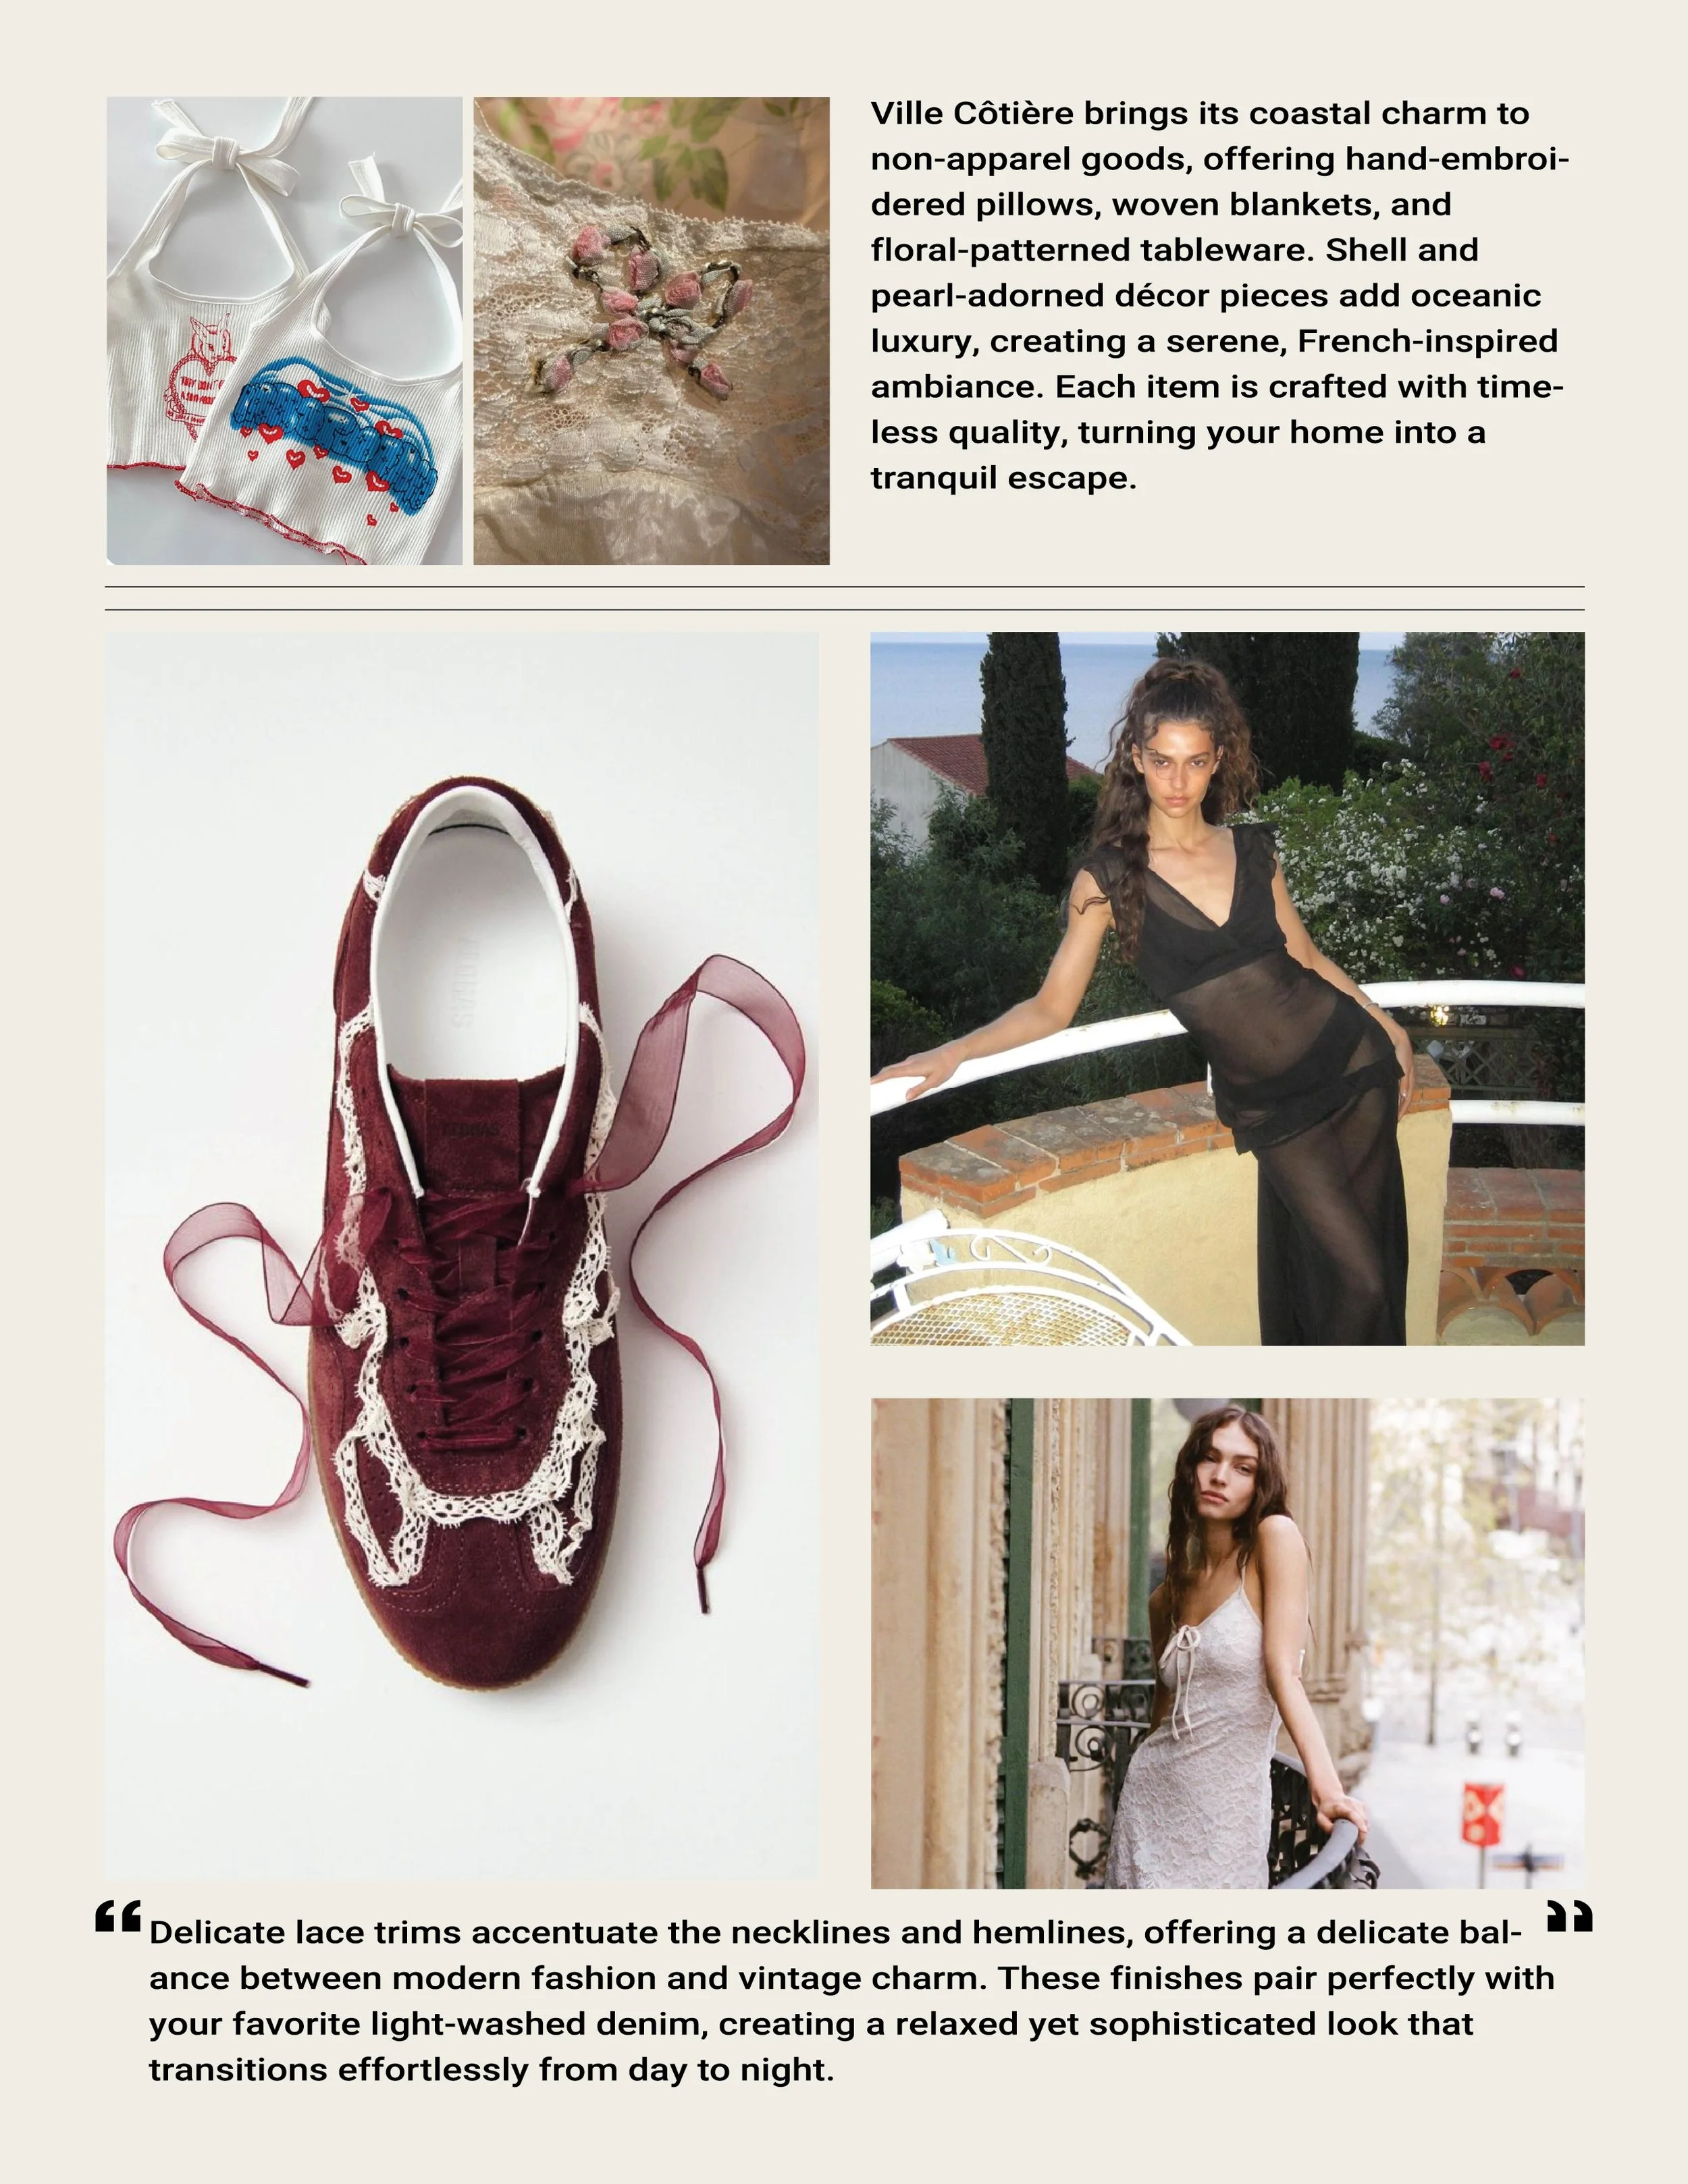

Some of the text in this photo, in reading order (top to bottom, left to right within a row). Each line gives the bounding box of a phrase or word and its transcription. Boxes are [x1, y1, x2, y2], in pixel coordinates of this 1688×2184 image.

[870, 100, 1529, 132] Ville Côtière brings its coastal charm to
[872, 145, 1569, 177] non-apparel goods, offering hand-embroi-
[871, 191, 1451, 222] dered pillows, woven blankets, and
[870, 236, 1478, 268] floral-patterned tableware. Shell and
[872, 282, 1541, 313] pearl-adorned décor pieces add oceanic
[872, 327, 1558, 359] luxury, creating a serene, French-inspired
[872, 373, 1564, 398] ambiance. Each item is crafted with time-
[872, 419, 1486, 450] less quality, turning your home into a
[870, 464, 1136, 496] tranquil escape.
[151, 1919, 285, 1944] Delicate
[296, 1919, 365, 1944] lace
[373, 1919, 461, 1944] trims
[472, 1922, 658, 1944] accentuate
[667, 1919, 721, 1944] the
[732, 1919, 891, 1944] necklines
[901, 1919, 961, 1944] and
[974, 1919, 1133, 1949] hemlines,
[1144, 1919, 1275, 1950] offering
[1288, 1925, 1306, 1944] a
[1317, 1919, 1449, 1944] delicate
[1460, 1919, 1522, 1944] bal-
[150, 1965, 1554, 1996] ance between modern fashion and vintage charm. These finishes pair perfectly with
[149, 2010, 1474, 2042] your favorite light-washed denim, creating a relaxed yet sophisticated look that
[148, 2056, 834, 2088] transitions effortlessly from day to night.
